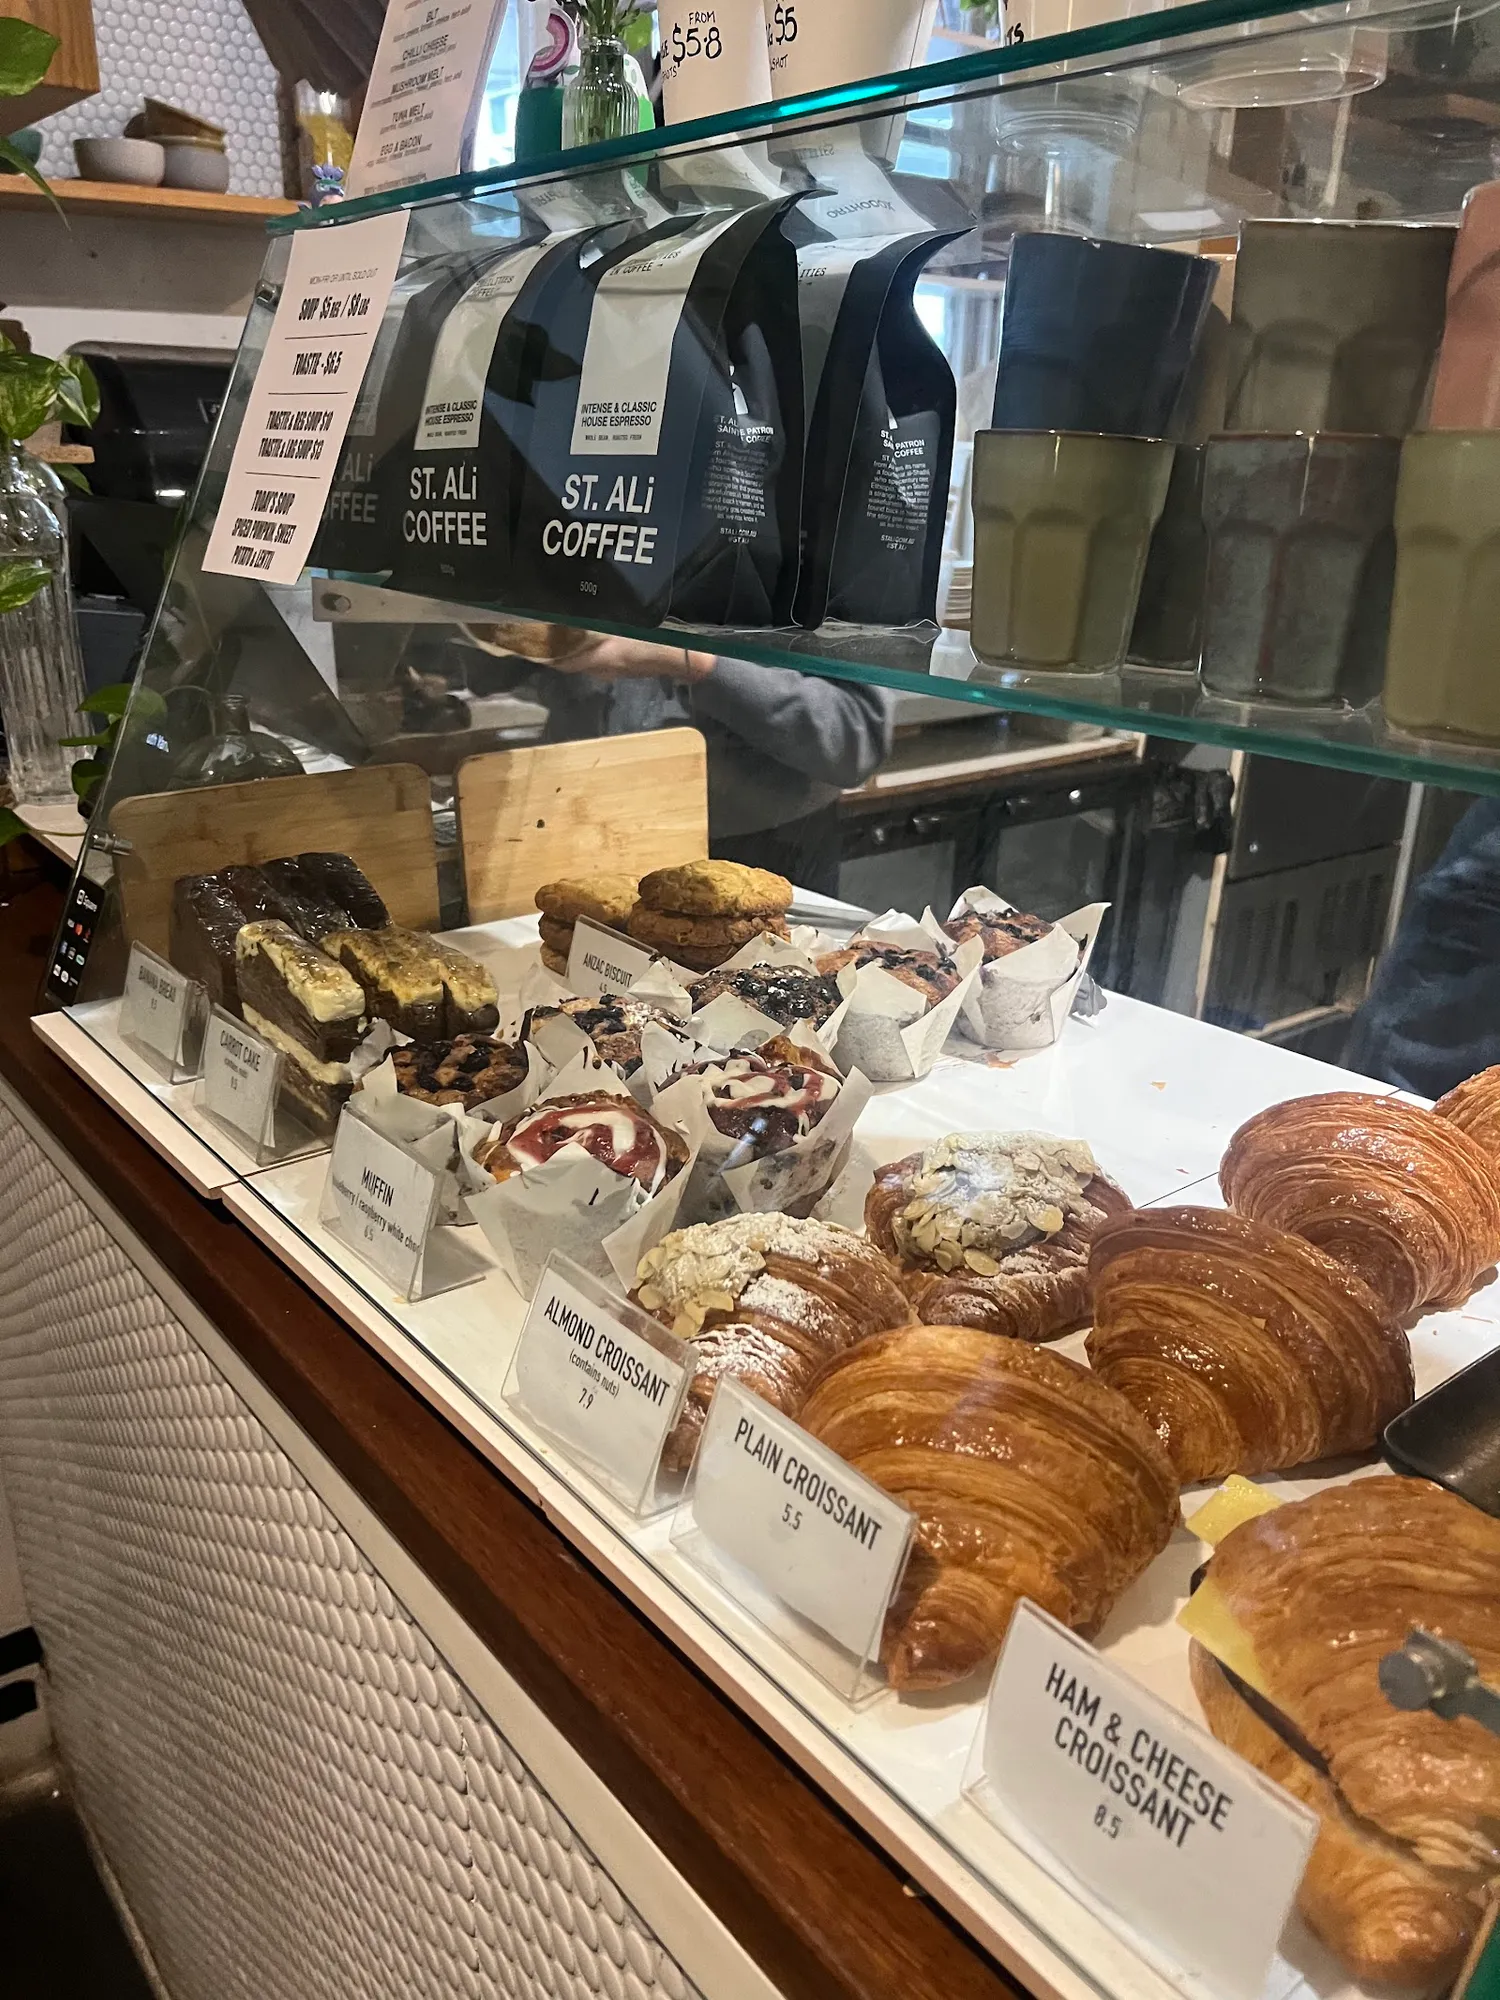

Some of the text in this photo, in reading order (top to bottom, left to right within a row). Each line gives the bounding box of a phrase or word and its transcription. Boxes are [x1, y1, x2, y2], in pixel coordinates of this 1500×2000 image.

[425, 7, 439, 22] BLT
[689, 11, 716, 25] FROM
[774, 3, 797, 45] $5
[422, 34, 449, 54] CHEESE
[298, 297, 321, 321] SOUP
[320, 295, 333, 321] $5
[347, 292, 362, 318] $8
[292, 352, 323, 375] TOASTIE
[323, 350, 343, 376] $6.5
[266, 410, 292, 431] TOASTIE
[303, 411, 323, 431] SOUP
[424, 412, 475, 427] HOUSE ESPRESSO
[425, 403, 447, 416] INTENSE
[452, 399, 478, 412] CLASSIC
[581, 401, 657, 415] INTENSE & CLASSIC
[581, 415, 653, 428] HOUSE ESPRESSO
[258, 438, 283, 459] TOASTIE
[294, 438, 315, 460] SOUP
[894, 439, 926, 451] PATRON
[894, 447, 925, 458] COFFEE
[409, 464, 477, 501] ST. ALi
[561, 473, 599, 511] ST.
[605, 474, 655, 514] ALi
[251, 489, 296, 515] TODAY'S SOUP
[231, 517, 254, 539] SPICED
[274, 523, 297, 545] SWEET
[402, 509, 488, 546] COFFEE
[542, 519, 659, 565] COFFEE
[579, 580, 598, 597] 500g
[583, 952, 633, 988] ANZAC BISCUIT
[220, 1029, 245, 1058] CARROT
[242, 1045, 261, 1072] CAKE
[361, 1166, 395, 1208] MUFFIN
[359, 1199, 387, 1232] raspberry
[386, 1220, 404, 1243] white
[543, 1294, 671, 1408] ALMOND CROISSANT
[568, 1347, 621, 1399] (contains nuts)
[578, 1386, 595, 1410] 7.9
[734, 1416, 883, 1552] PLAIN CROISSANT
[781, 1502, 803, 1531] 5.5
[1045, 1661, 1234, 1834] HAM & CHEESE
[1054, 1715, 1196, 1849] CROISSANT
